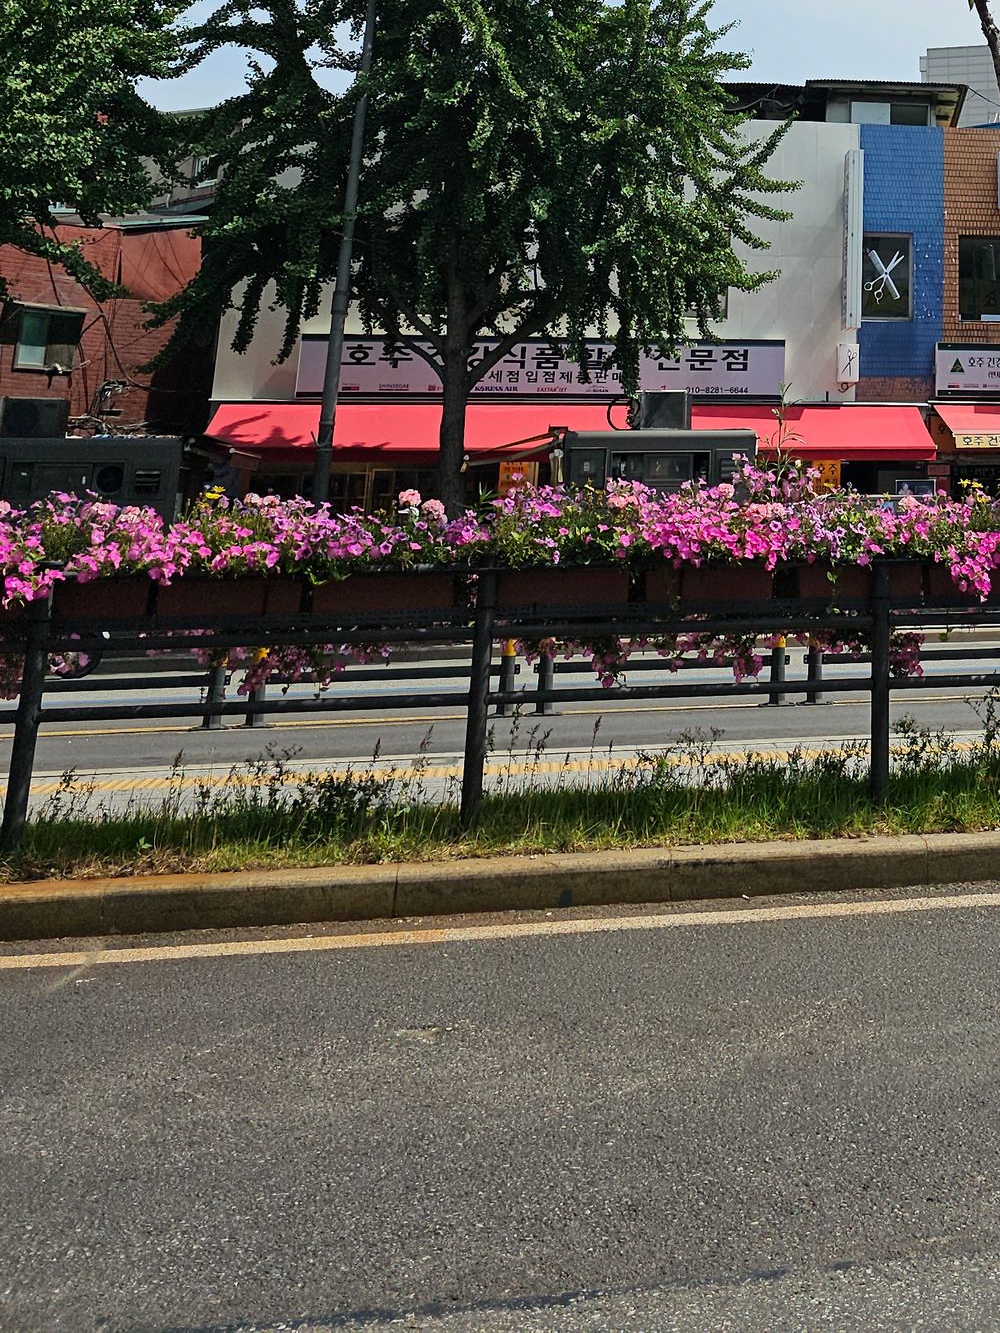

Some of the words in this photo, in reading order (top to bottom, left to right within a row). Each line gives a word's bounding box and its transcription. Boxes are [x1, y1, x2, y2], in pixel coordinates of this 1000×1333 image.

[968, 356, 984, 368] 호주
[686, 386, 749, 394] 010-8281-6644
[962, 436, 984, 446] 호주
